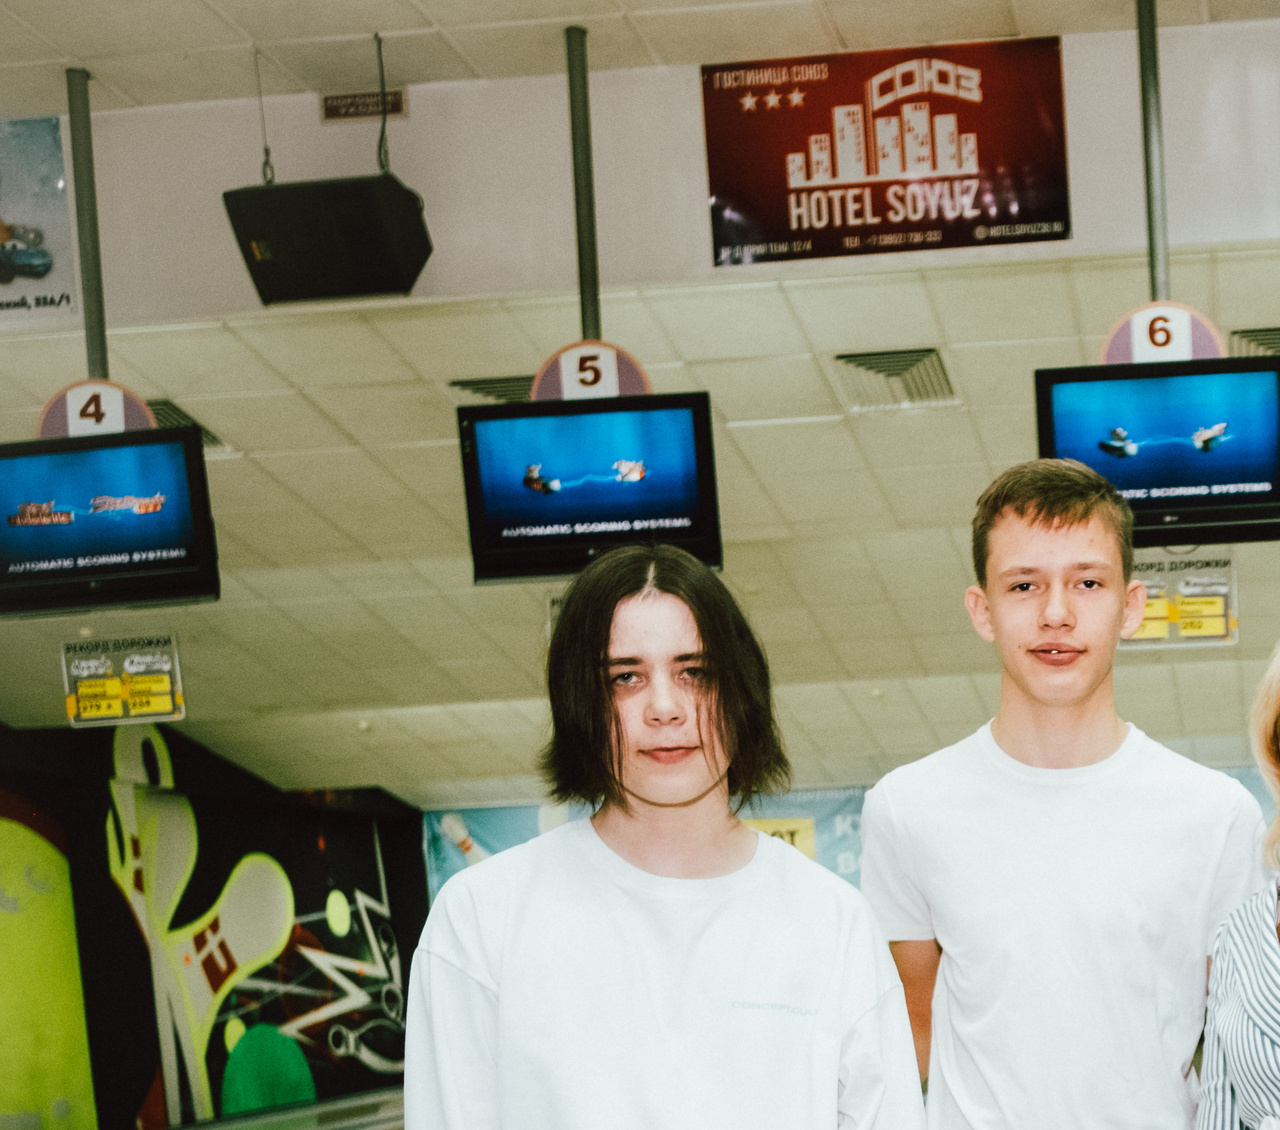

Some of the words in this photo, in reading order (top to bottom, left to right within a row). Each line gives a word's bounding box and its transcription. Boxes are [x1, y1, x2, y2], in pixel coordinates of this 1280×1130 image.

[713, 65, 790, 90] ГОСТИНИЦА
[793, 62, 829, 83] СОЮЗ
[871, 57, 984, 111] СОЮЗ
[788, 187, 882, 231] HOTEL
[886, 178, 981, 221] SOYUZ
[1147, 315, 1173, 348] 6
[577, 354, 602, 387] 5
[79, 391, 106, 425] 4
[1150, 485, 1209, 498] SCORING
[1211, 482, 1272, 496] SYSTEMS
[8, 557, 74, 574] AUTOMATIC
[1133, 560, 1165, 572] КОРД
[1168, 558, 1231, 572] ДОРОЖКИ
[65, 640, 110, 654] РЕКОРД
[113, 636, 172, 652] ДОРОЖКИ
